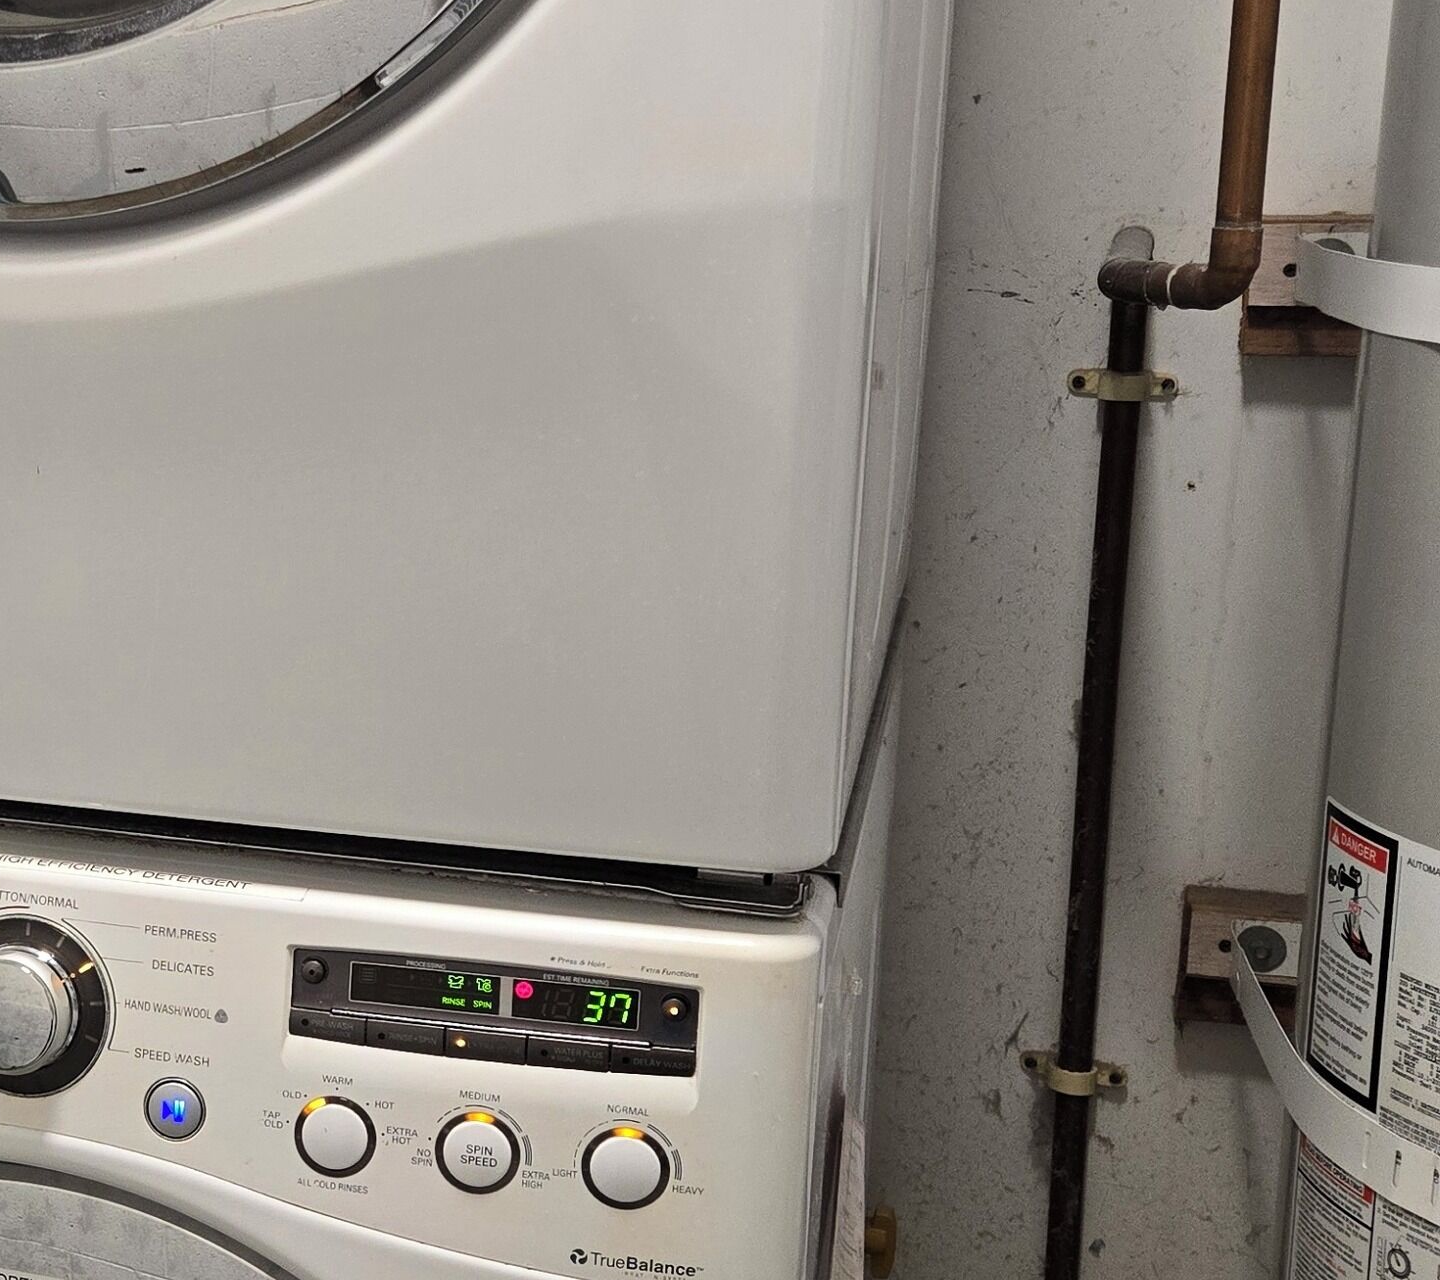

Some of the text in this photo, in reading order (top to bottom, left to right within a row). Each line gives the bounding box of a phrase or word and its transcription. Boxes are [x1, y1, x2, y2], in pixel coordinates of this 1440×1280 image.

[1340, 832, 1377, 863] DANGER
[142, 871, 252, 890] DETERGENT
[144, 924, 217, 943] PERM.PRESS
[152, 959, 215, 977] DELICATES
[405, 959, 447, 970] PROCESSING
[661, 967, 699, 979] Functions
[573, 976, 610, 986] REMAINING
[124, 998, 212, 1020] HAND WASH/WOOL
[441, 996, 493, 1010] RINSE SPIN
[583, 990, 632, 1024] 37
[134, 1047, 210, 1068] SPEED WASH
[554, 1047, 604, 1060] WATER PLUS
[632, 1057, 691, 1070] DELAY WASH
[322, 1074, 353, 1086] WARM
[281, 1089, 302, 1099] OLD
[459, 1090, 501, 1103] MEDIUM
[374, 1100, 395, 1110] HOT
[606, 1104, 649, 1117] NORMAL
[263, 1110, 281, 1119] TAP
[263, 1119, 283, 1130] OLD
[386, 1126, 418, 1137] EXTRA
[391, 1136, 412, 1145] HOT
[416, 1147, 432, 1157] NO
[466, 1144, 494, 1156] SPIN
[411, 1157, 433, 1167] SPIN
[460, 1154, 498, 1168] SPEED
[521, 1170, 550, 1181] EXTRA
[552, 1169, 578, 1179] LIGHT
[338, 1183, 369, 1194] RINSES
[521, 1180, 543, 1189] HIGH
[671, 1185, 705, 1196] HEAVY
